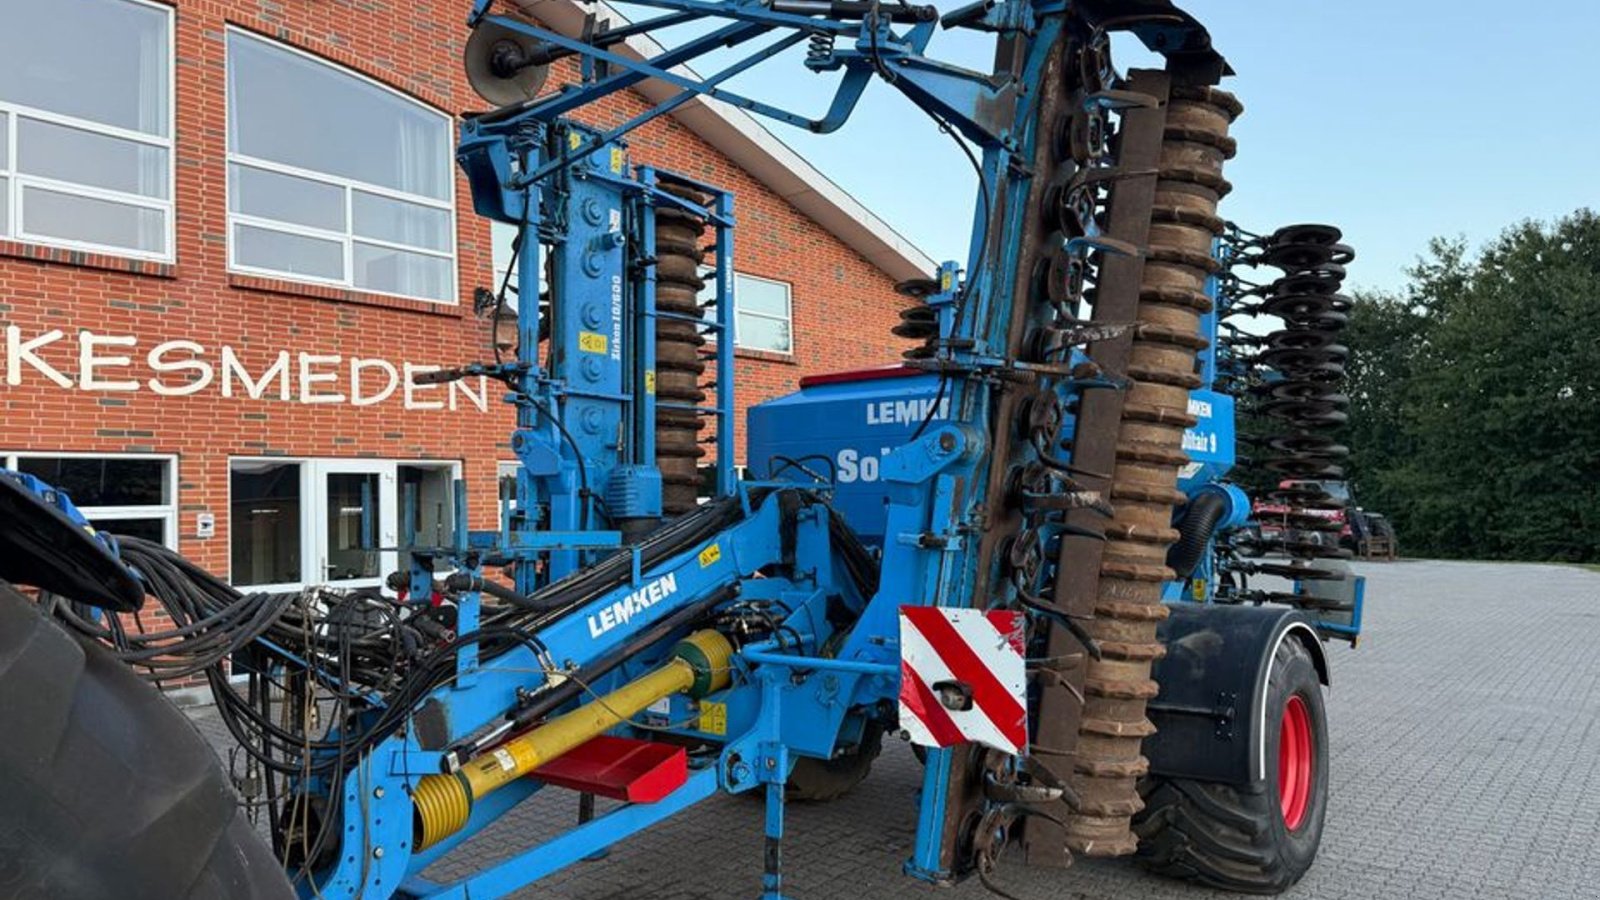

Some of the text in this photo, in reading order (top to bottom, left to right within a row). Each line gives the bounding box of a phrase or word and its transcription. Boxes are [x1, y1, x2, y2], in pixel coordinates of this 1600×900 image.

[7, 325, 487, 413] KESMEDEN
[611, 323, 621, 361] Zirkon
[588, 573, 677, 638] LEMKEN
